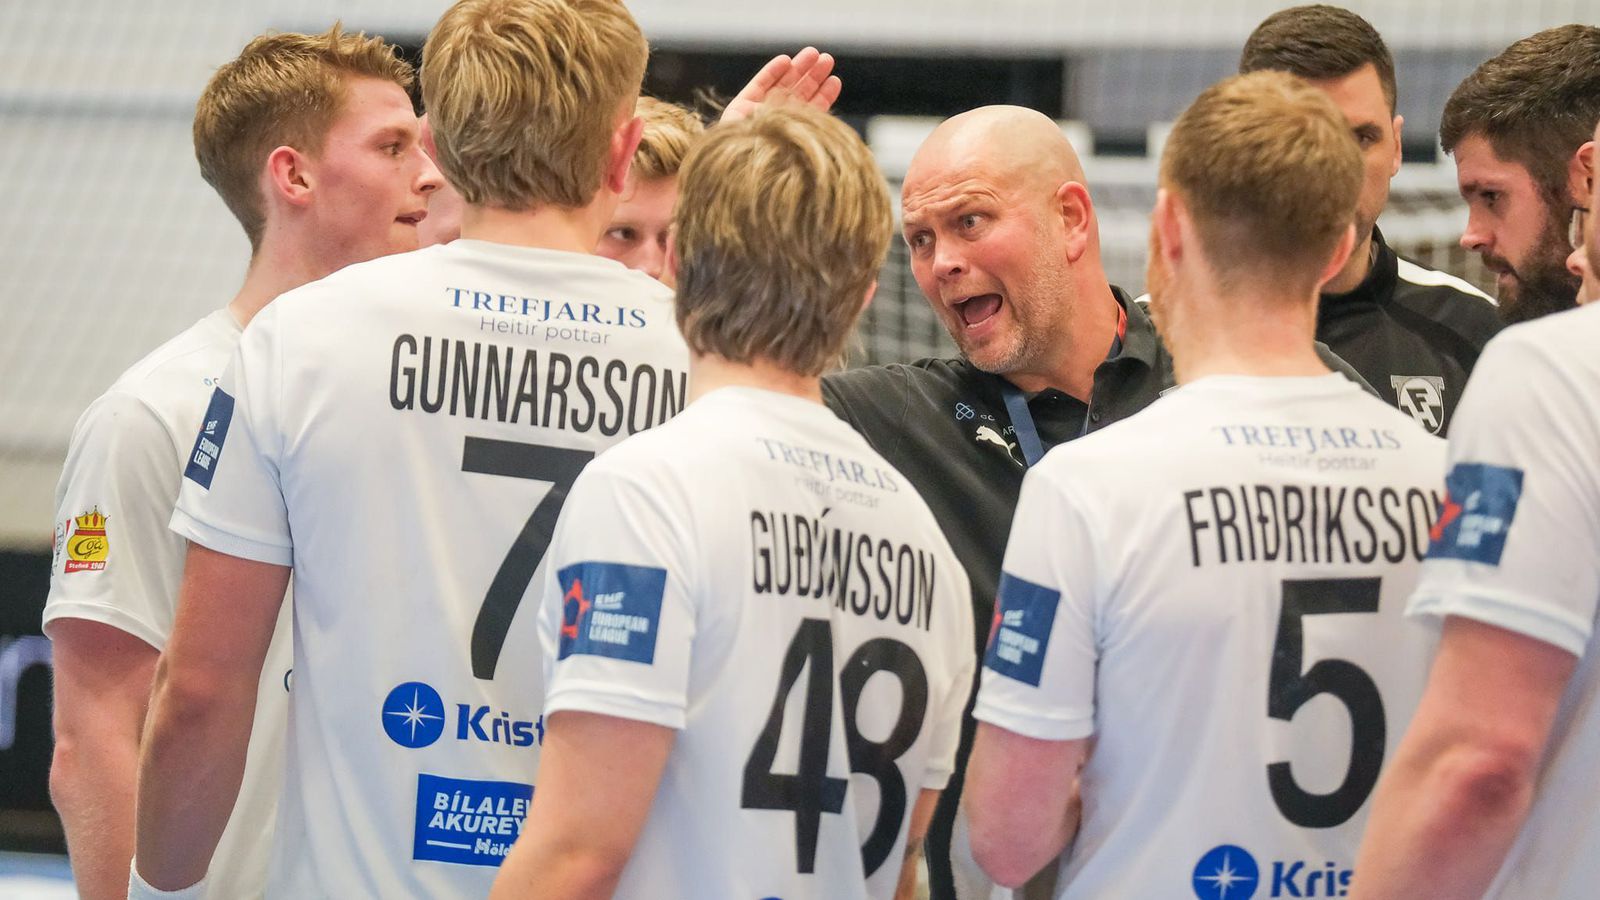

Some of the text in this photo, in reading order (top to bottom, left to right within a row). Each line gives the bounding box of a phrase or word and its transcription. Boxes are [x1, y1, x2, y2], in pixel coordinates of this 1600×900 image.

[446, 287, 647, 329] TREFJAR.IS
[479, 315, 611, 346] Heitir pottar
[389, 333, 688, 437] GUNNARSSON
[755, 437, 899, 493] TREFJAR.IS
[1212, 424, 1402, 454] TREFJAR.IS
[461, 435, 596, 681] 7
[1266, 576, 1386, 828] 5
[741, 617, 928, 880] 48
